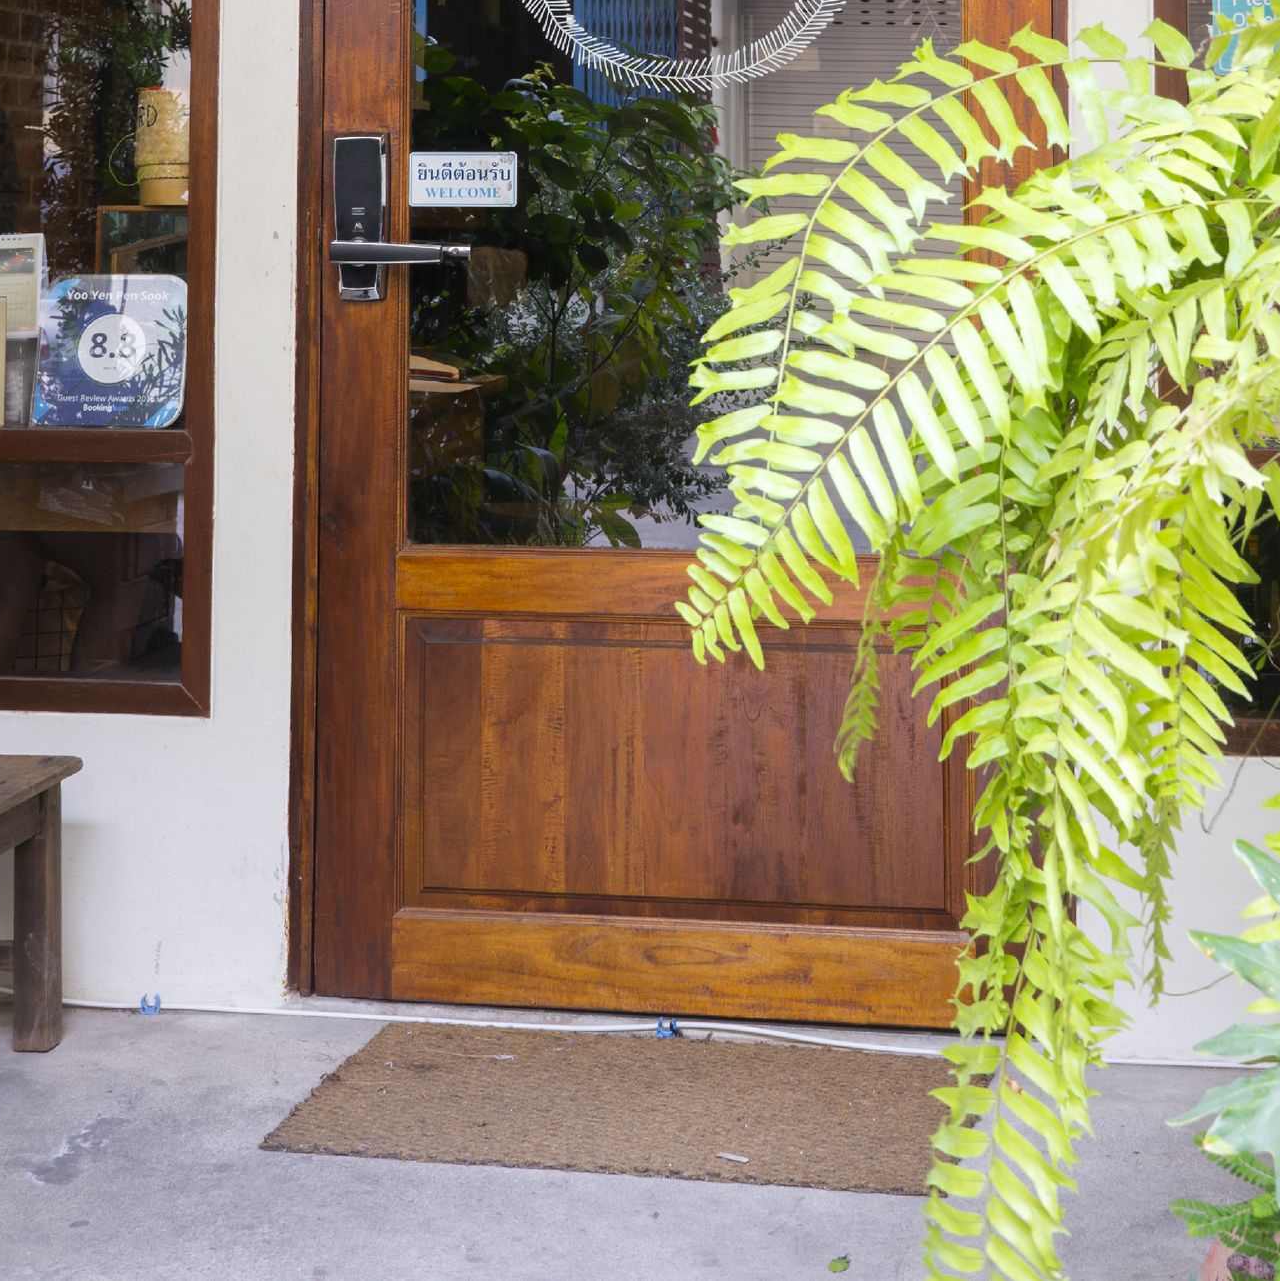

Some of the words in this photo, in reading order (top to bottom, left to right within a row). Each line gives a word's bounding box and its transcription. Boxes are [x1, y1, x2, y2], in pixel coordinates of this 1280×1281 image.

[417, 161, 511, 181] ยินดีต้อนรับ
[425, 187, 501, 198] WELCOME
[67, 290, 89, 300] Yoo
[91, 290, 113, 300] Yen
[116, 290, 138, 300] Pen
[140, 290, 170, 300] Sook
[89, 332, 137, 359] 8.8
[57, 394, 79, 402] Guest
[81, 394, 106, 402] Review
[108, 394, 135, 402] Awards
[83, 404, 130, 412] Booking.com
